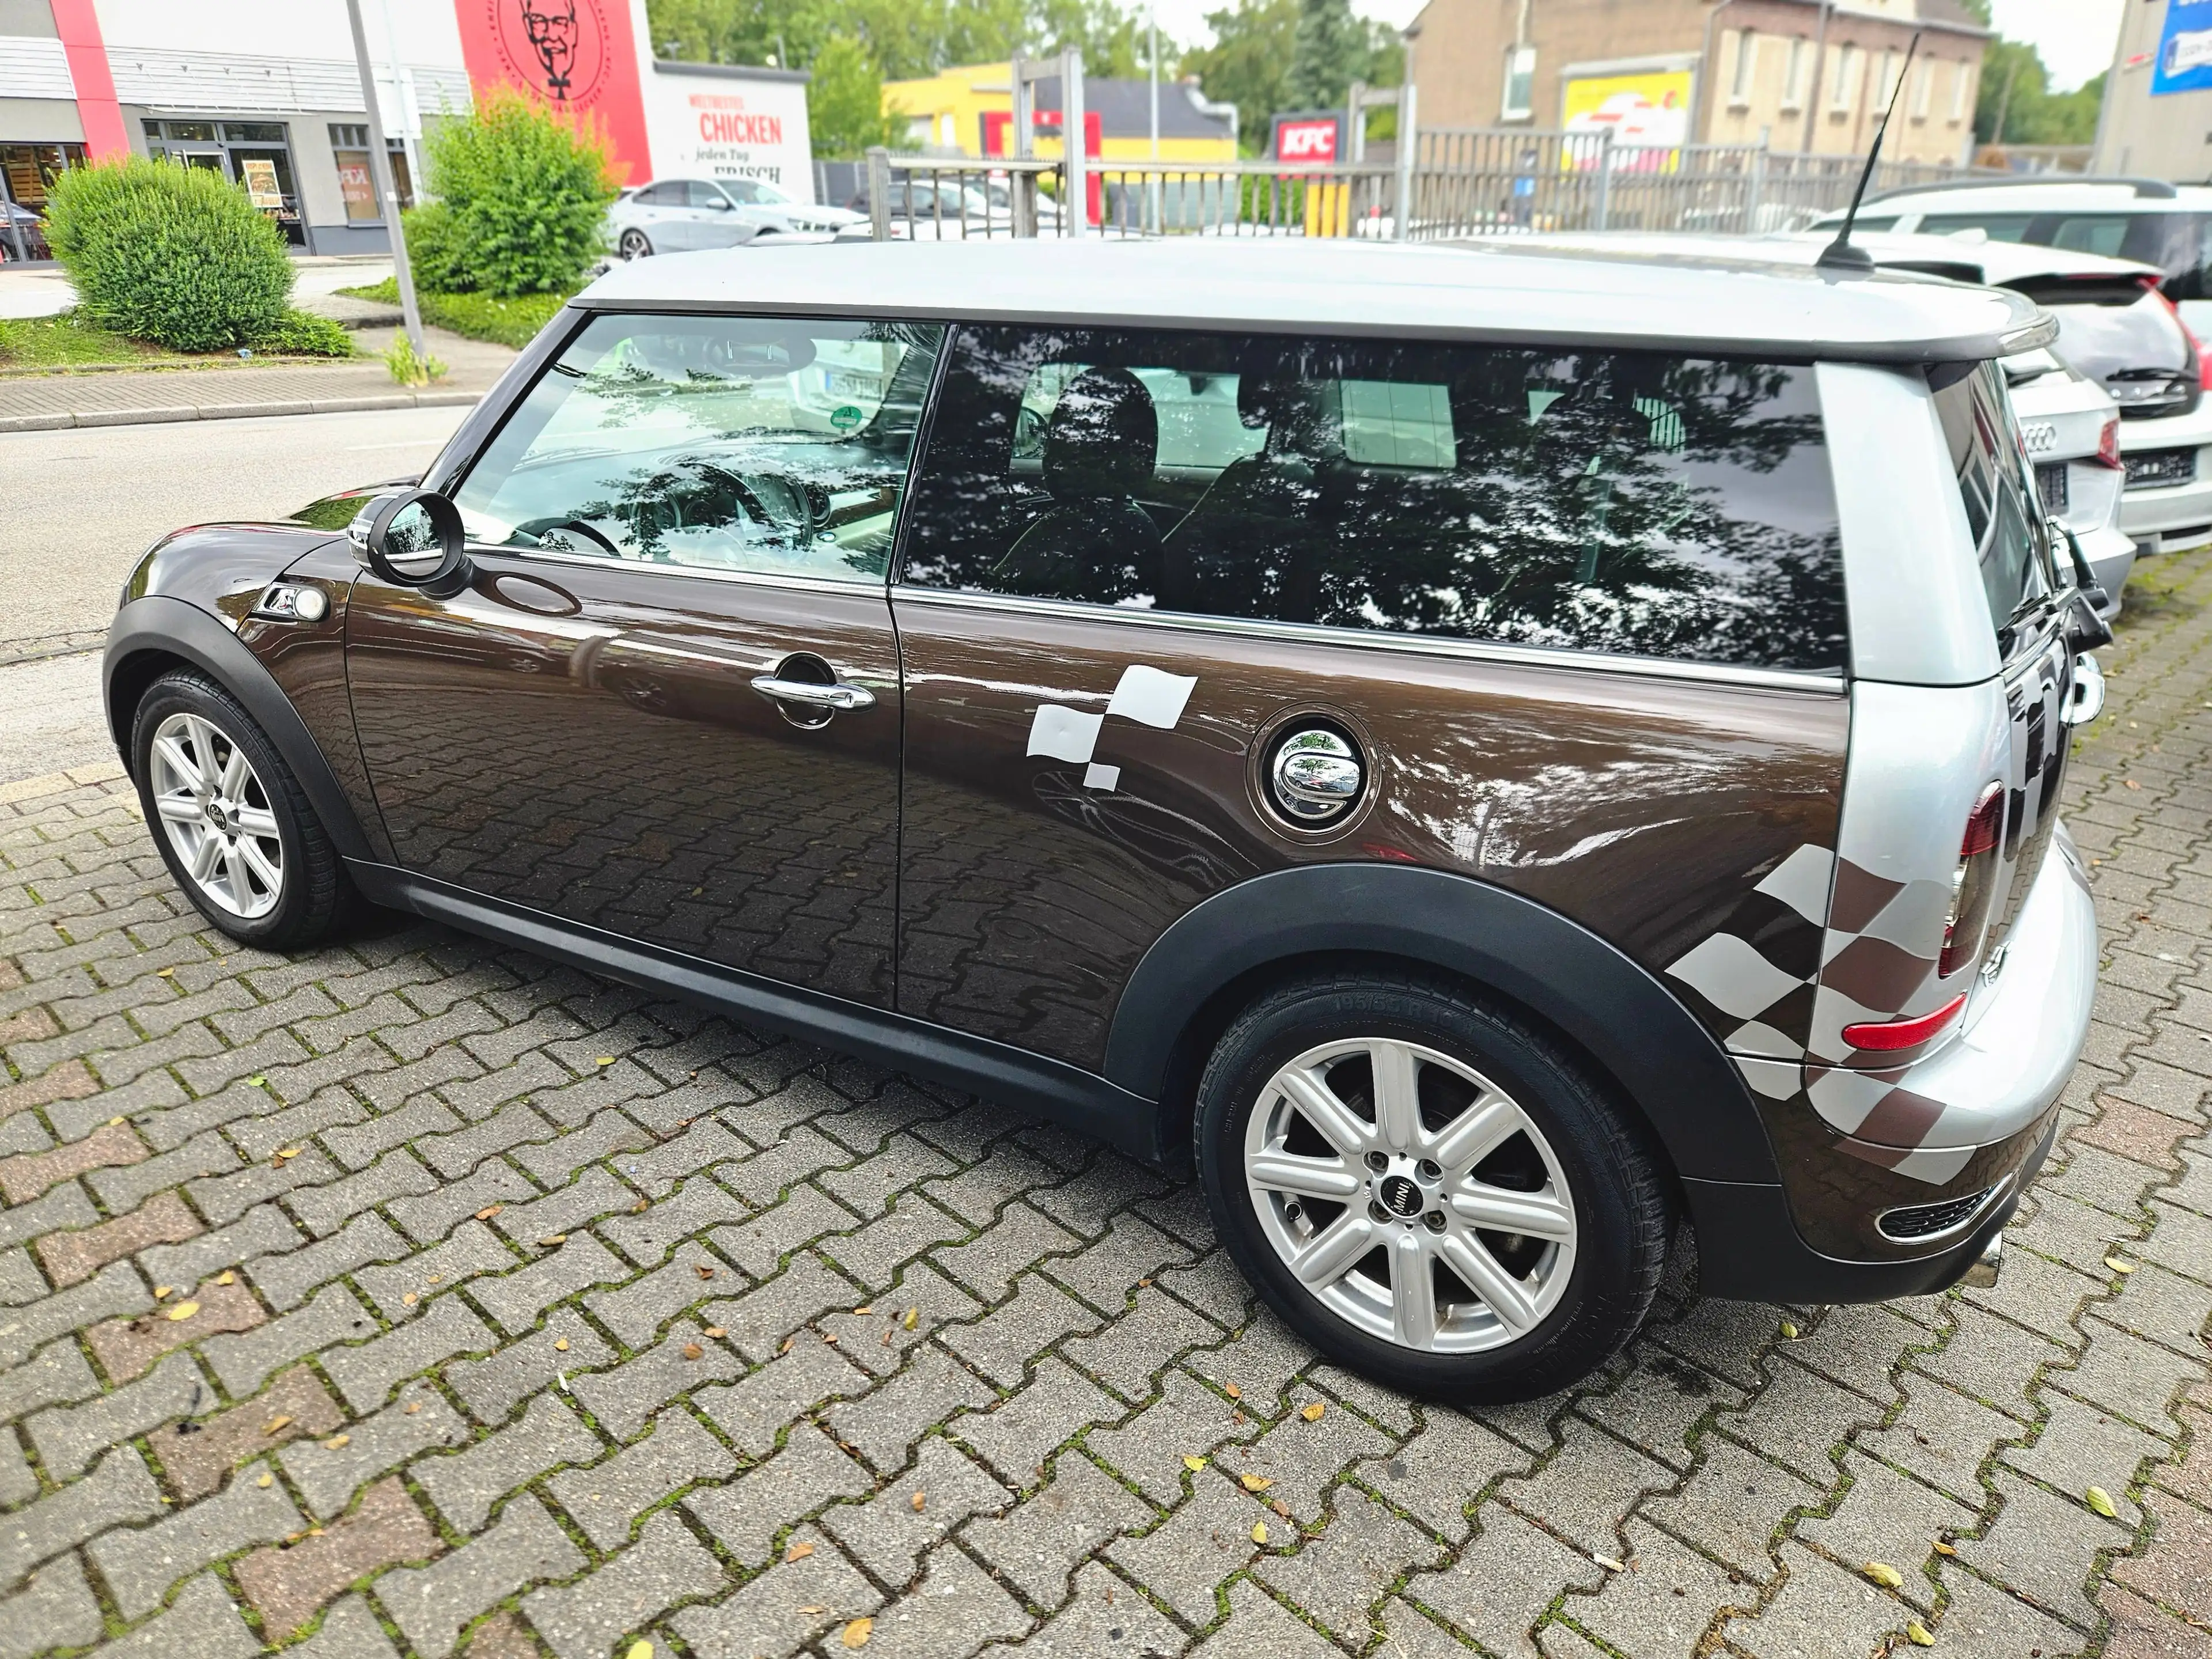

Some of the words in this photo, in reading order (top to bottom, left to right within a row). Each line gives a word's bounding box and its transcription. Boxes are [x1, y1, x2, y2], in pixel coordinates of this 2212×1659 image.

[699, 112, 782, 145] CHICKEN
[1282, 126, 1334, 154] KFC
[1393, 1182, 1410, 1212] MINI
